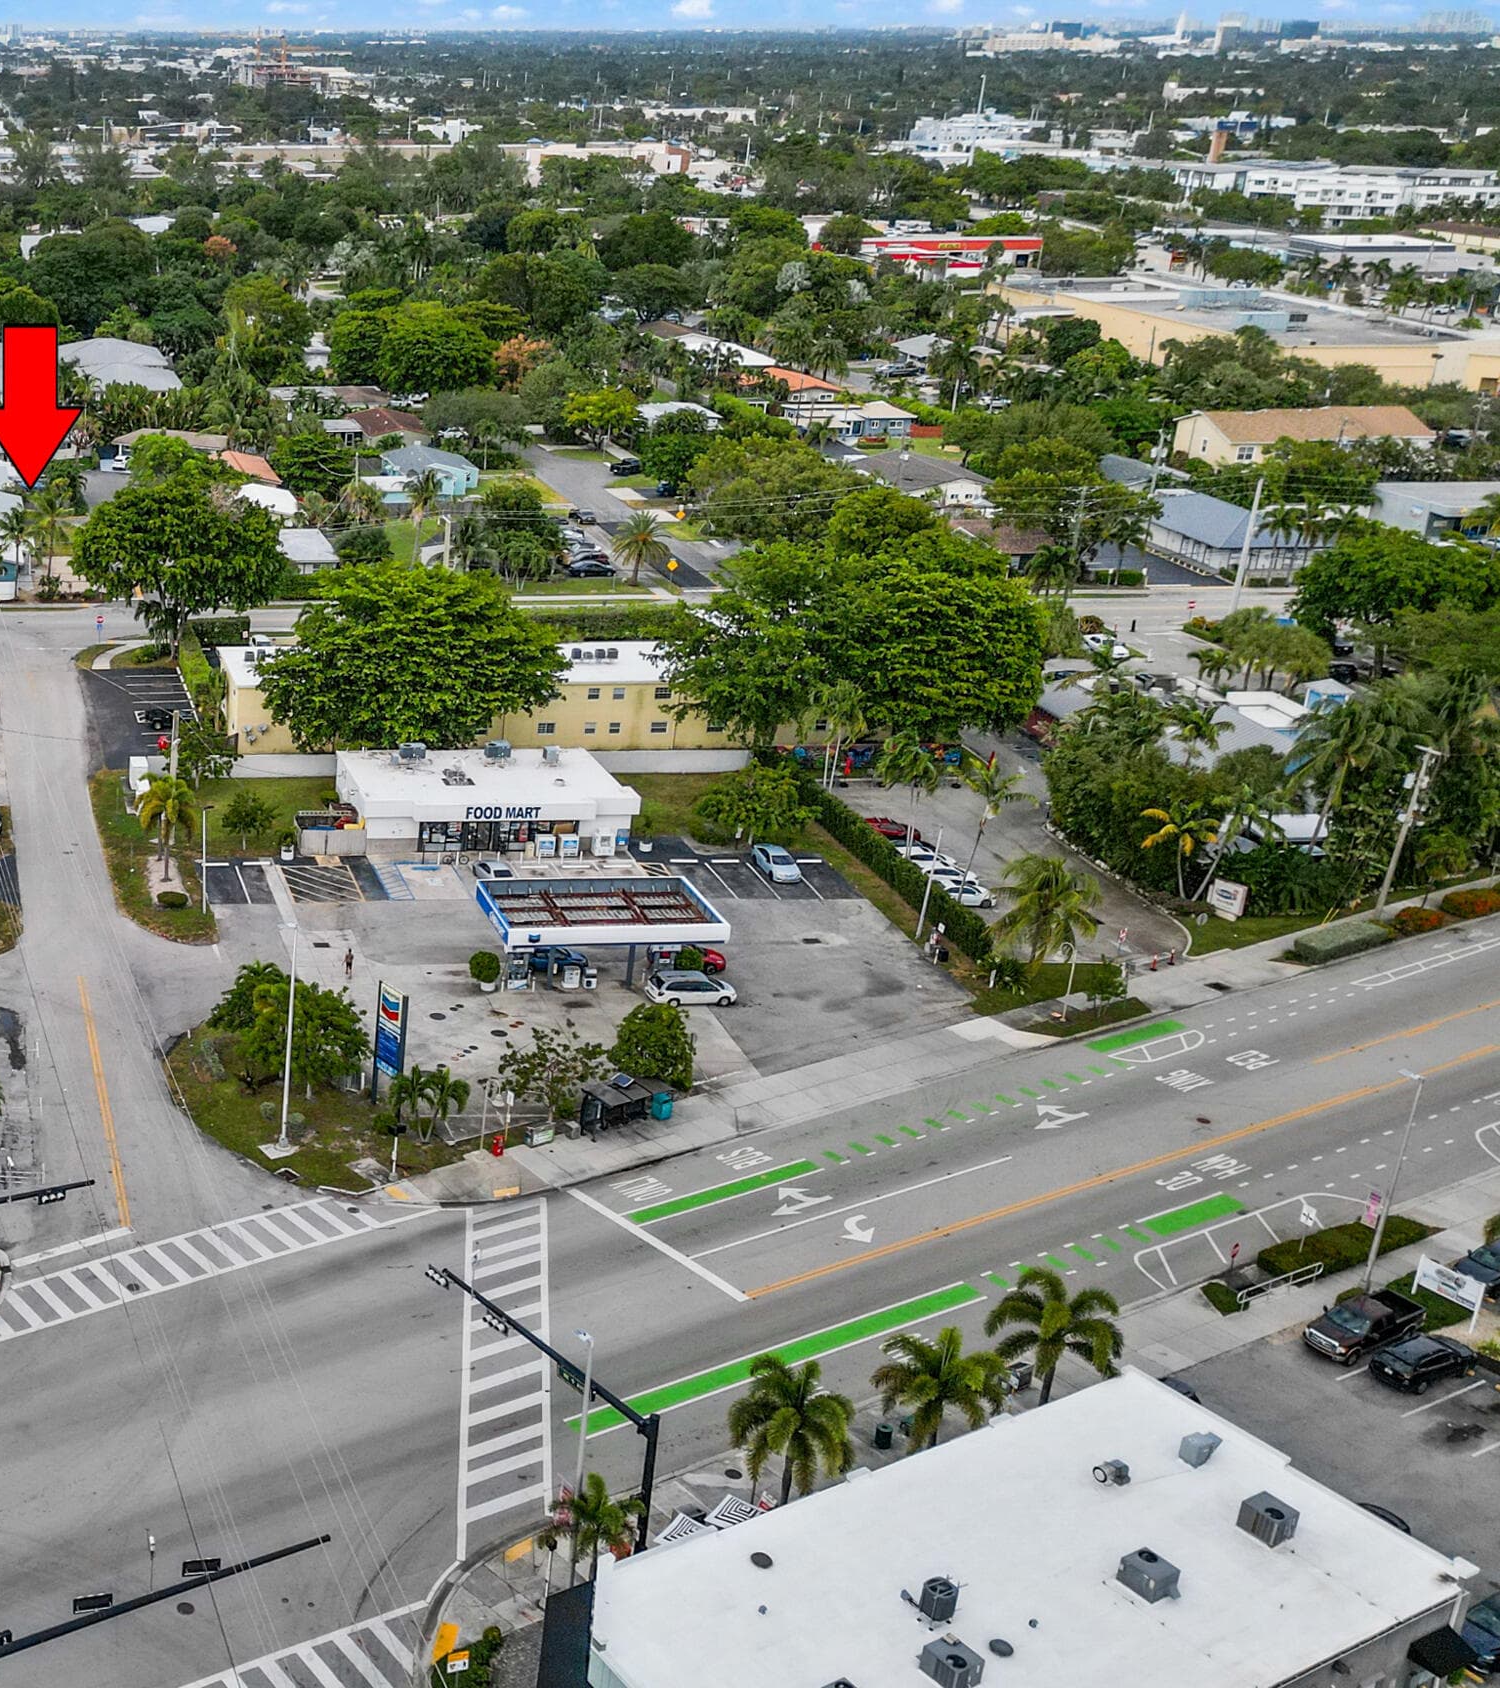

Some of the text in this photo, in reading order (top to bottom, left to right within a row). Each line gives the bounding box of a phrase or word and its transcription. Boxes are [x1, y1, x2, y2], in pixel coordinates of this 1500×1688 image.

[466, 806, 541, 819] FOOD MART
[1226, 1049, 1280, 1071] PED
[1154, 1069, 1215, 1093] XING
[715, 1146, 774, 1171] BUS
[1190, 1153, 1253, 1180] MPH
[608, 1175, 674, 1203] ONLY
[1154, 1170, 1204, 1191] 30
